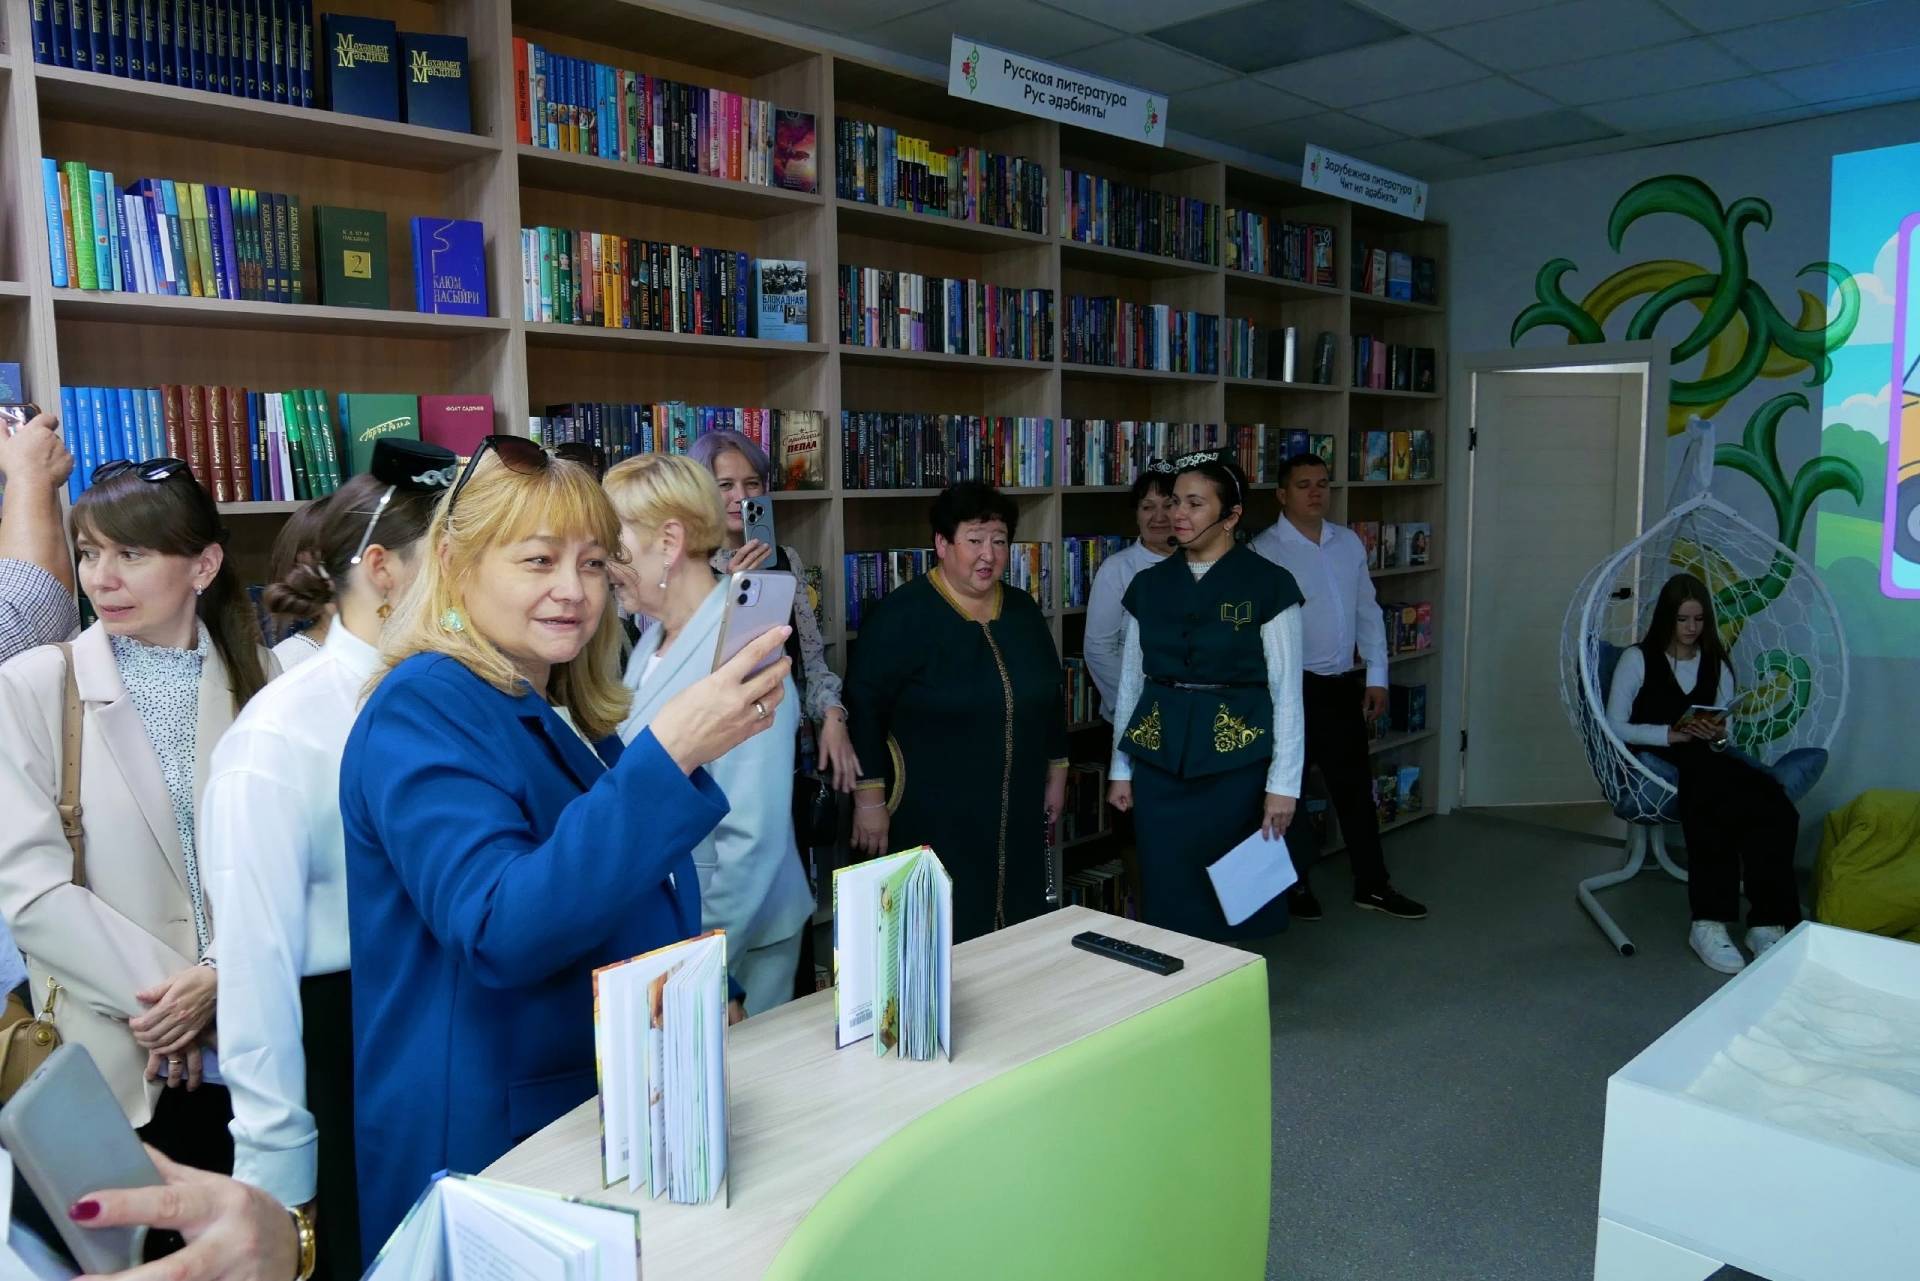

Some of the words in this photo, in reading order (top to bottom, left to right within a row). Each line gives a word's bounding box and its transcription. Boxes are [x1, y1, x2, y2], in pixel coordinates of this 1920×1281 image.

[38, 41, 48, 54] 1
[58, 46, 67, 58] 1
[76, 49, 87, 62] 2
[95, 53, 105, 65] 2
[114, 55, 124, 68] 3
[132, 58, 141, 71] 3
[147, 61, 156, 73] 4
[163, 63, 172, 76] 4
[180, 66, 189, 78] 5
[195, 69, 204, 81] 5
[208, 73, 217, 85] 6
[221, 75, 229, 87] 6
[233, 76, 242, 88] 7
[247, 78, 256, 90] 7
[1003, 59, 1053, 87] Русская
[1056, 77, 1127, 108] литература
[261, 80, 271, 92] 8
[276, 82, 286, 94] 8
[291, 86, 301, 98] 9
[304, 87, 313, 100] 9
[1024, 85, 1045, 105] Рус
[1048, 94, 1106, 119] әдәбияты
[1324, 157, 1371, 182] Зарубежная
[1371, 175, 1412, 195] литература
[1339, 177, 1353, 190] Чит
[351, 255, 364, 274] 2
[762, 294, 804, 305] БЛОКАДНАЯ
[762, 303, 784, 313] КНИГА
